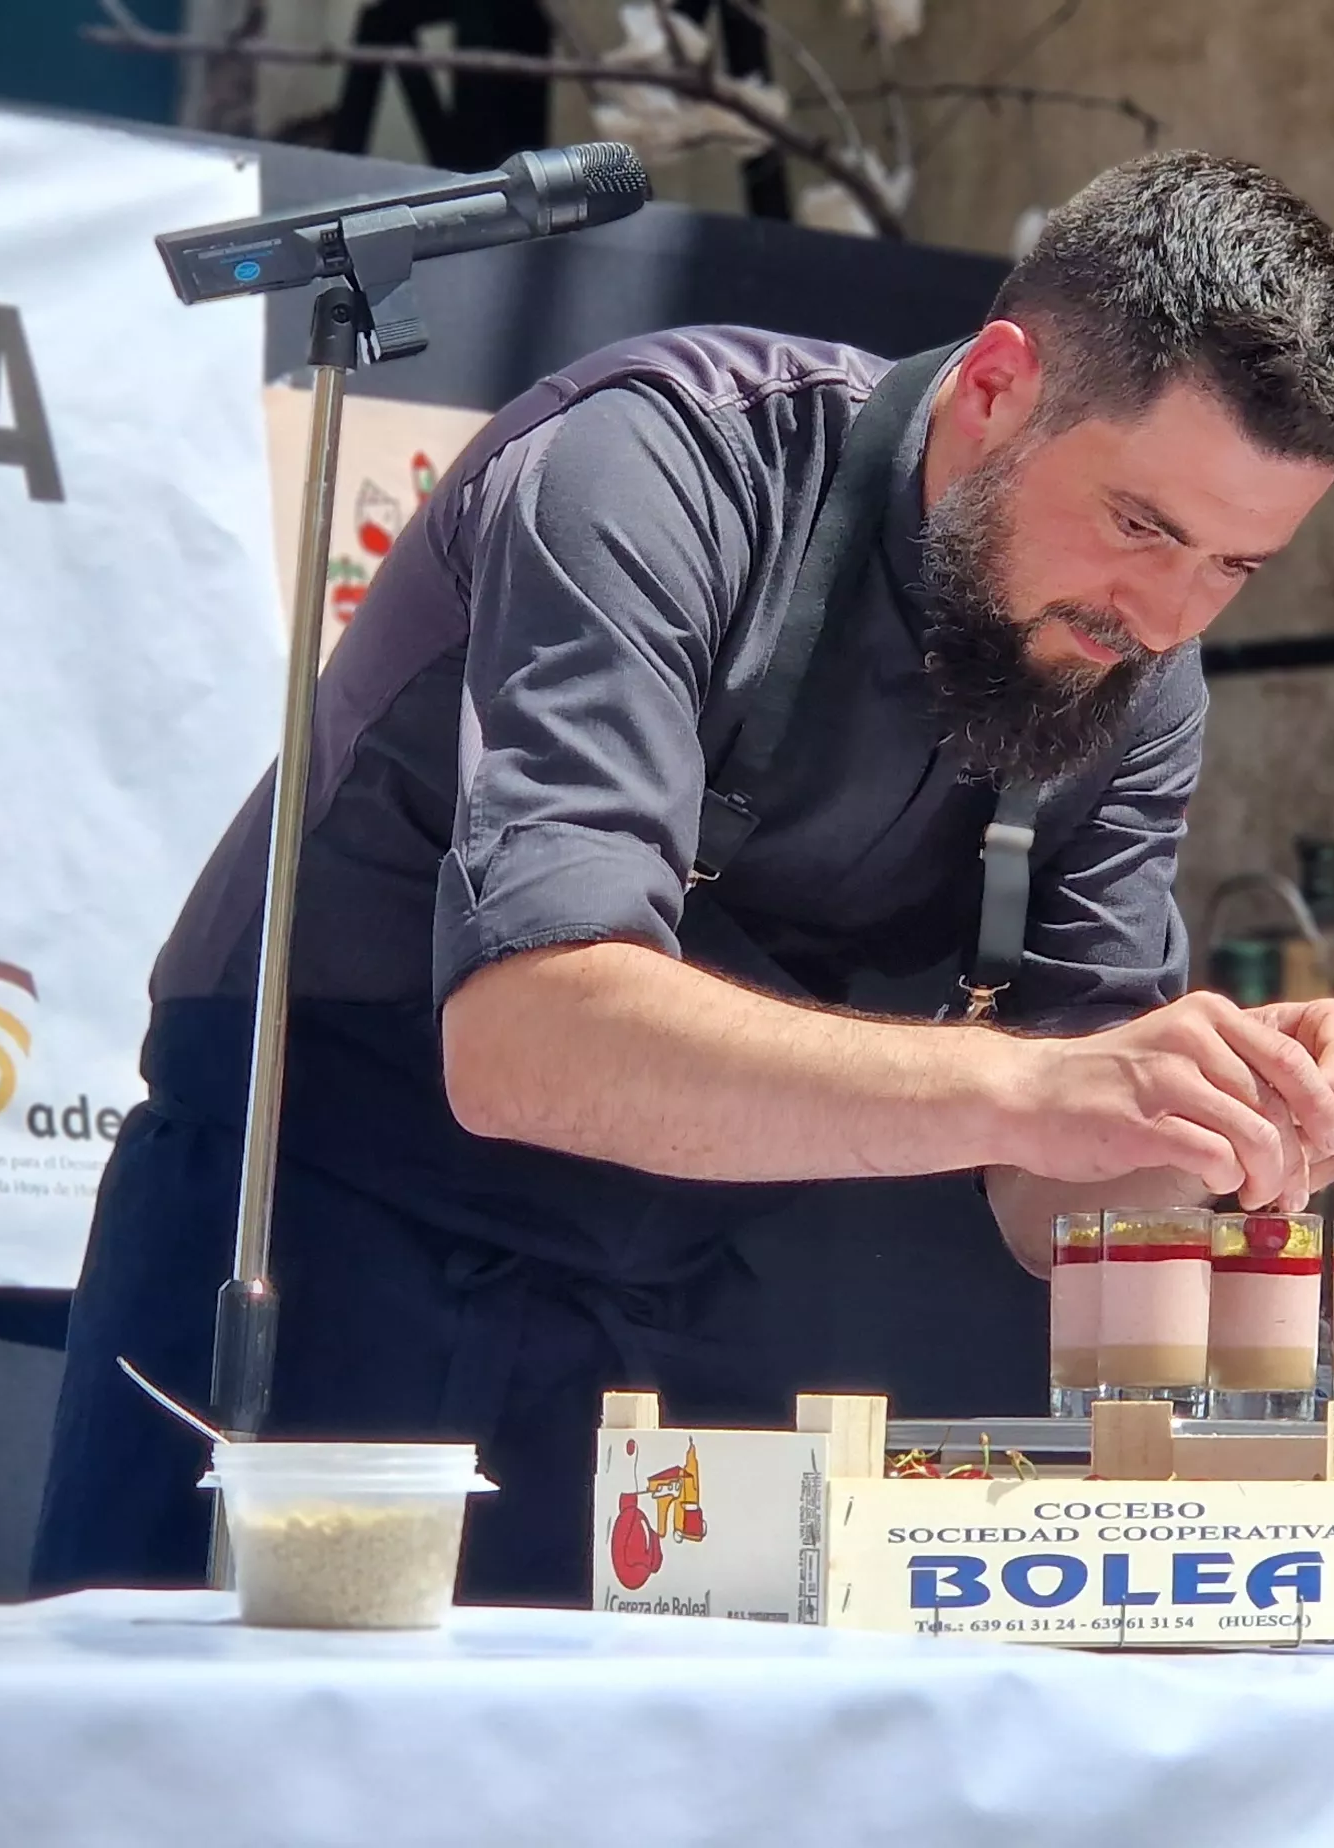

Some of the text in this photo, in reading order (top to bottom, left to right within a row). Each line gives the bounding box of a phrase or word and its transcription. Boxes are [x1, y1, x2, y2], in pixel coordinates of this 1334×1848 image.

[26, 1093, 124, 1142] ade
[1033, 1502, 1206, 1520] COCEBO
[887, 1527, 1080, 1544] SOCIEDAD
[906, 1551, 1325, 1610] BOLEA
[970, 1619, 1002, 1633] 639
[1006, 1618, 1025, 1632] 61
[1030, 1618, 1049, 1632] 31
[1056, 1617, 1076, 1631] 24
[1091, 1617, 1122, 1630] 639
[1126, 1616, 1145, 1630] 61
[1150, 1616, 1169, 1629] 31
[1174, 1616, 1195, 1629] 54
[1218, 1614, 1312, 1630] (HUESCA)
